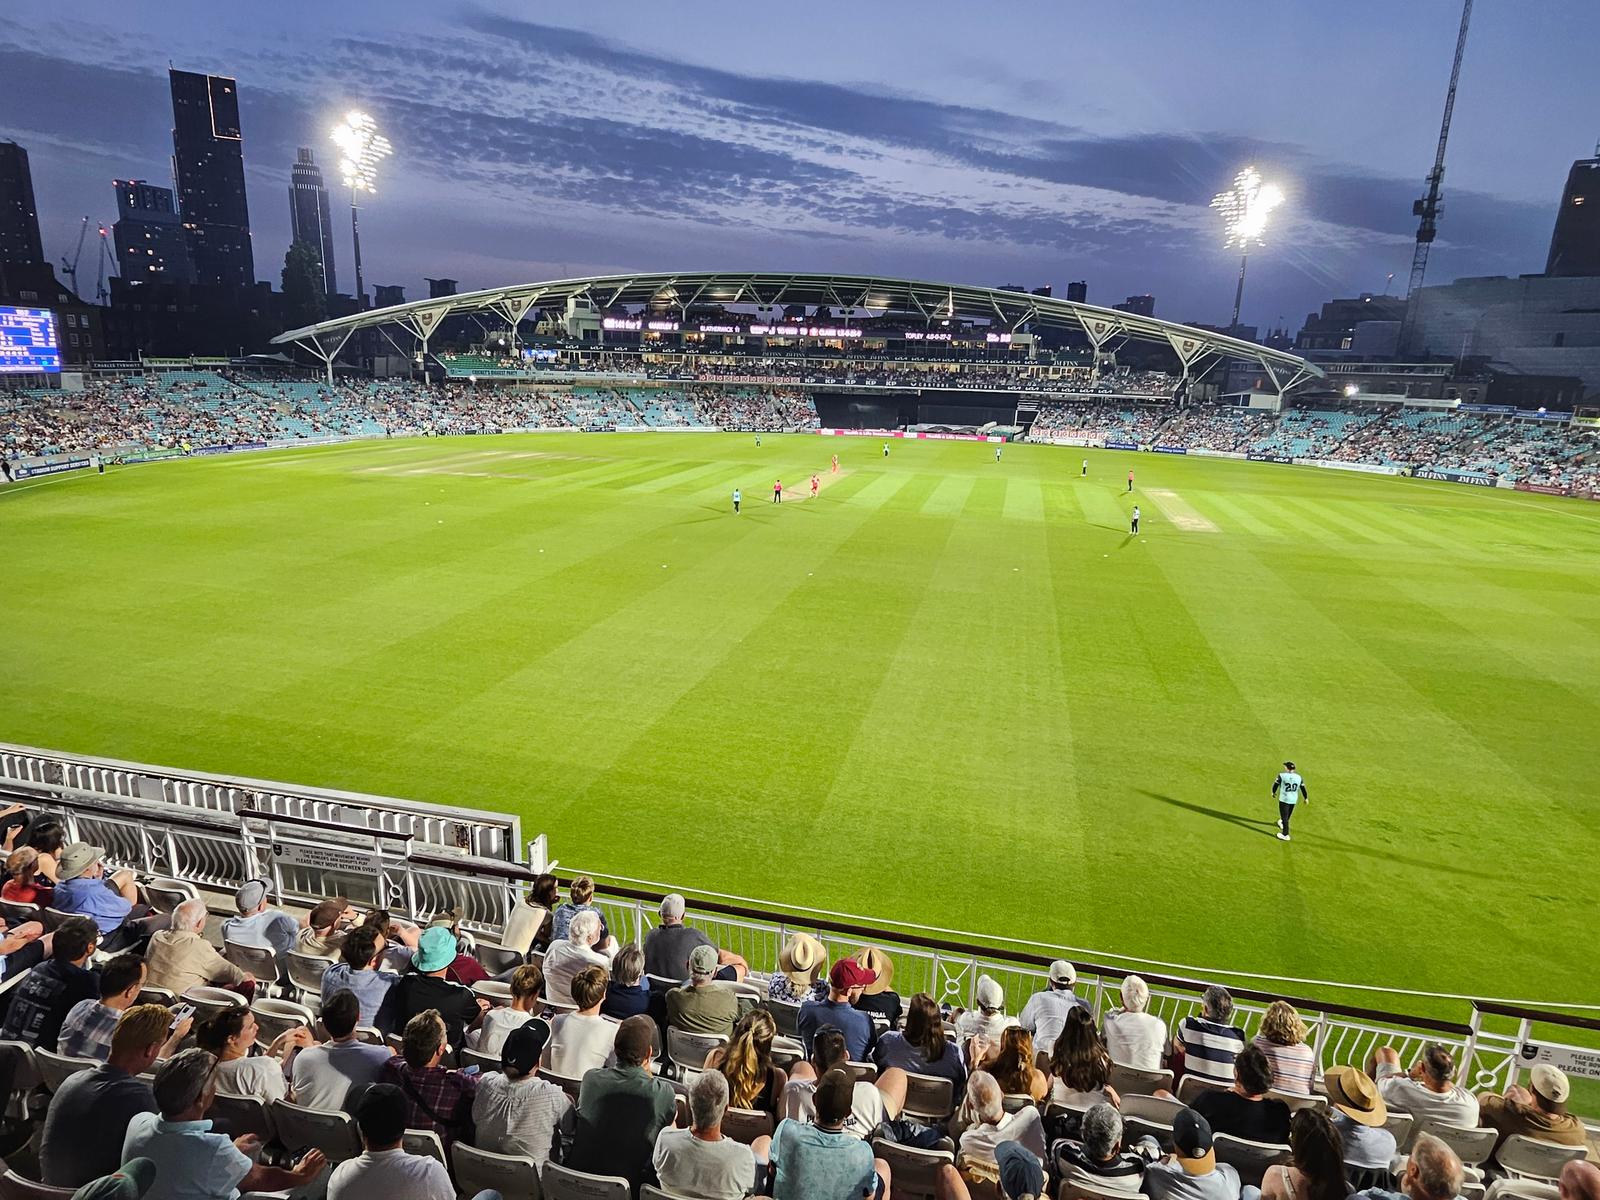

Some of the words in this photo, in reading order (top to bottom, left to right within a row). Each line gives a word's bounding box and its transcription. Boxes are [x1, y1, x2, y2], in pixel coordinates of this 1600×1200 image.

[1428, 472, 1448, 480] FINN
[1470, 477, 1490, 485] FINN
[1285, 783, 1298, 792] 20
[1558, 1064, 1586, 1074] PLEASE
